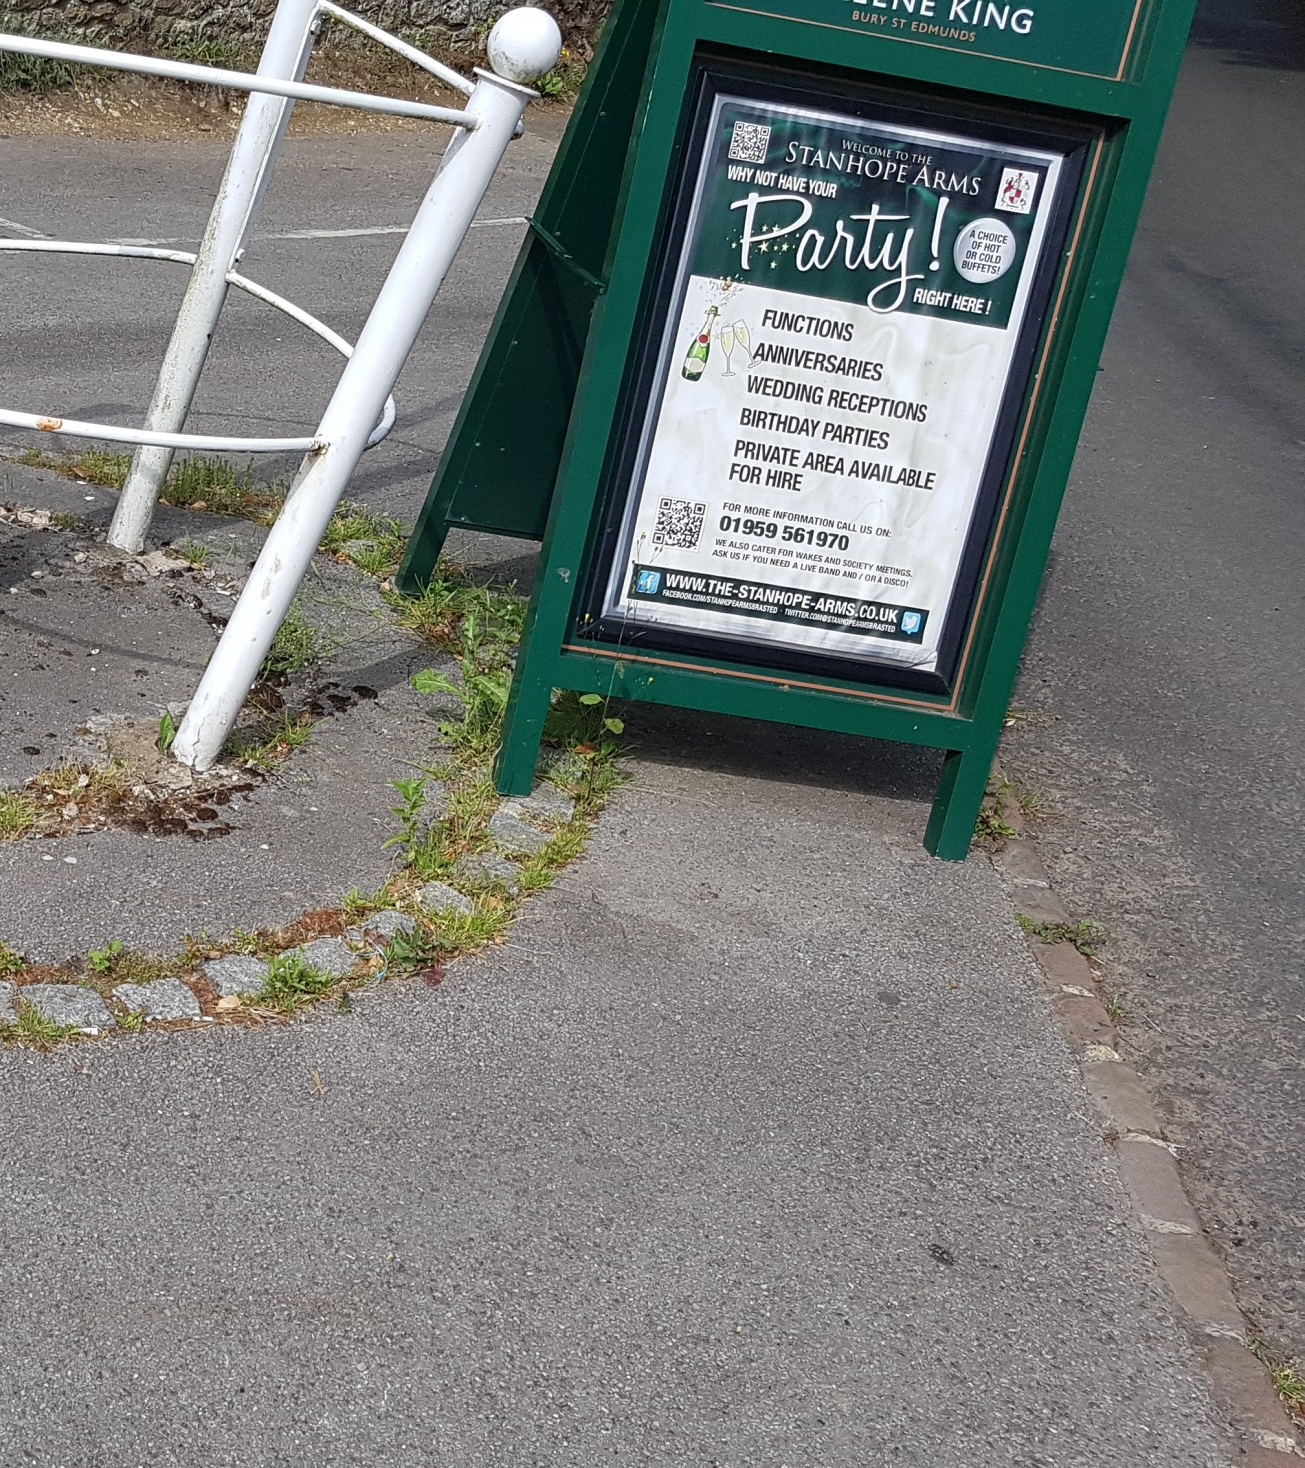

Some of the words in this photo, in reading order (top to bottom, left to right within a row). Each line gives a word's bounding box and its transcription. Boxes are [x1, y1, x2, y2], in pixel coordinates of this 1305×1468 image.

[851, 10, 888, 25] BURY
[891, 18, 907, 29] ST
[910, 21, 977, 42] EDMUNDS
[948, 0, 1035, 34] KING
[785, 141, 911, 184] STANHOPE
[912, 165, 983, 196] ARMS
[842, 139, 892, 158] WELCOME
[894, 150, 910, 162] TO
[911, 153, 933, 166] THE
[727, 164, 755, 182] WHY
[753, 169, 778, 188] NOT
[778, 175, 810, 193] HAVE
[808, 179, 838, 198] YOUR
[729, 192, 950, 313] Party!
[969, 229, 976, 239] A
[977, 230, 1009, 245] CHOICE
[971, 240, 983, 251] OF
[984, 242, 1002, 254] HOT
[961, 260, 1001, 275] BUFFETS!
[965, 250, 978, 261] OR
[979, 251, 1002, 265] COLD
[913, 287, 952, 308] RIGHT
[761, 309, 855, 342] FUNCTIONS
[752, 342, 884, 382] ANNIVERSARIES
[747, 374, 825, 406] WEDDING
[826, 388, 928, 423] RECEPTIONS
[739, 407, 821, 438] BIRTHDAY
[821, 421, 890, 450] PARTIES
[728, 462, 762, 485] FOR
[765, 468, 804, 492] HIRE
[733, 439, 801, 468] PRIVATE
[801, 451, 845, 476] AREA
[847, 459, 936, 490] AVAILABLE
[719, 515, 778, 539] 01959
[781, 525, 850, 551] 561970
[722, 502, 742, 513] FOR
[743, 505, 771, 518] MORE
[772, 509, 835, 529] INFORMATION
[836, 520, 857, 533] CALL
[859, 525, 873, 535] US
[875, 527, 892, 538] ON:
[712, 549, 728, 560] ASK
[729, 552, 741, 561] US
[741, 553, 751, 562] IF
[752, 555, 768, 565] YOU
[769, 557, 791, 568] NEED
[791, 561, 799, 570] A
[800, 562, 818, 573] LIVE
[818, 565, 841, 577] BAND
[841, 569, 858, 580] AND
[864, 573, 876, 582] OR
[876, 575, 883, 584] A
[883, 575, 909, 588] DISCO!
[715, 538, 727, 547] WE
[728, 540, 750, 551] ALSO
[751, 543, 776, 556] CATER
[777, 548, 794, 558] FOR
[795, 551, 823, 563] WAKES
[824, 556, 841, 566] AND
[842, 559, 874, 571] SOCIETY
[875, 564, 913, 578] MEETINGS.
[666, 573, 899, 623] WWW.THE-STANHOPE-ARMS.CO.UK
